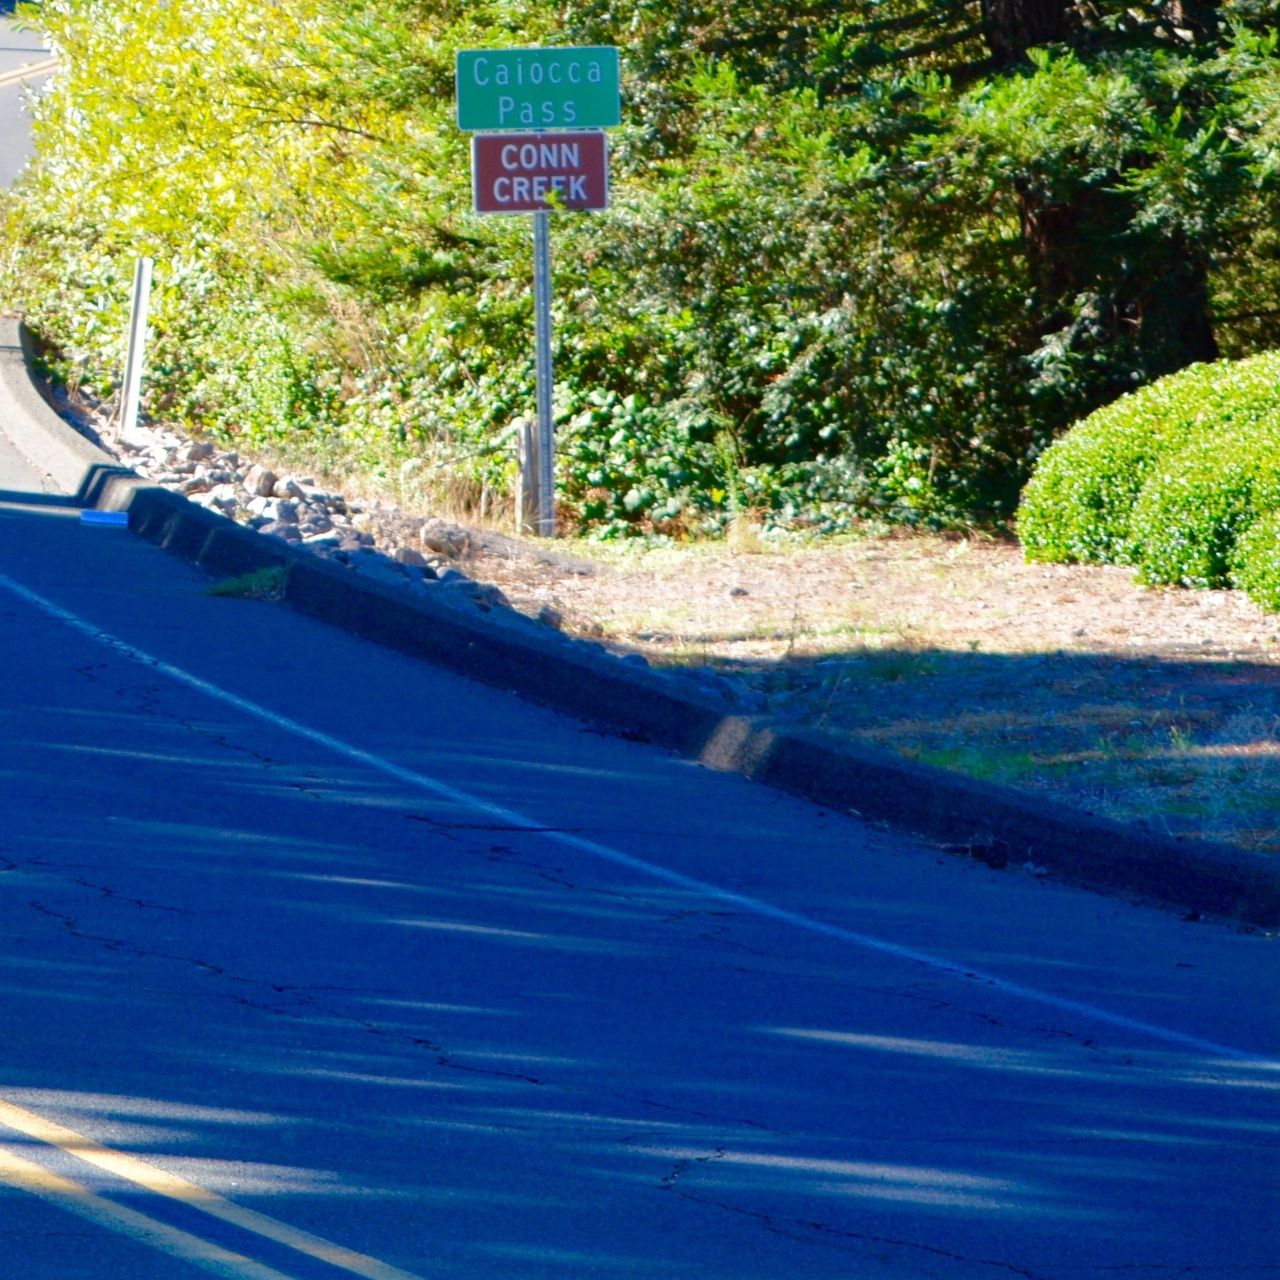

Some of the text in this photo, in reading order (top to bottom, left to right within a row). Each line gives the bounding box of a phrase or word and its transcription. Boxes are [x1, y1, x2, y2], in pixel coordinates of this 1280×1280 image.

[474, 57, 601, 86] Caiocca
[498, 96, 576, 125] Pass
[501, 143, 579, 170] CONN
[493, 175, 588, 202] CREEK
